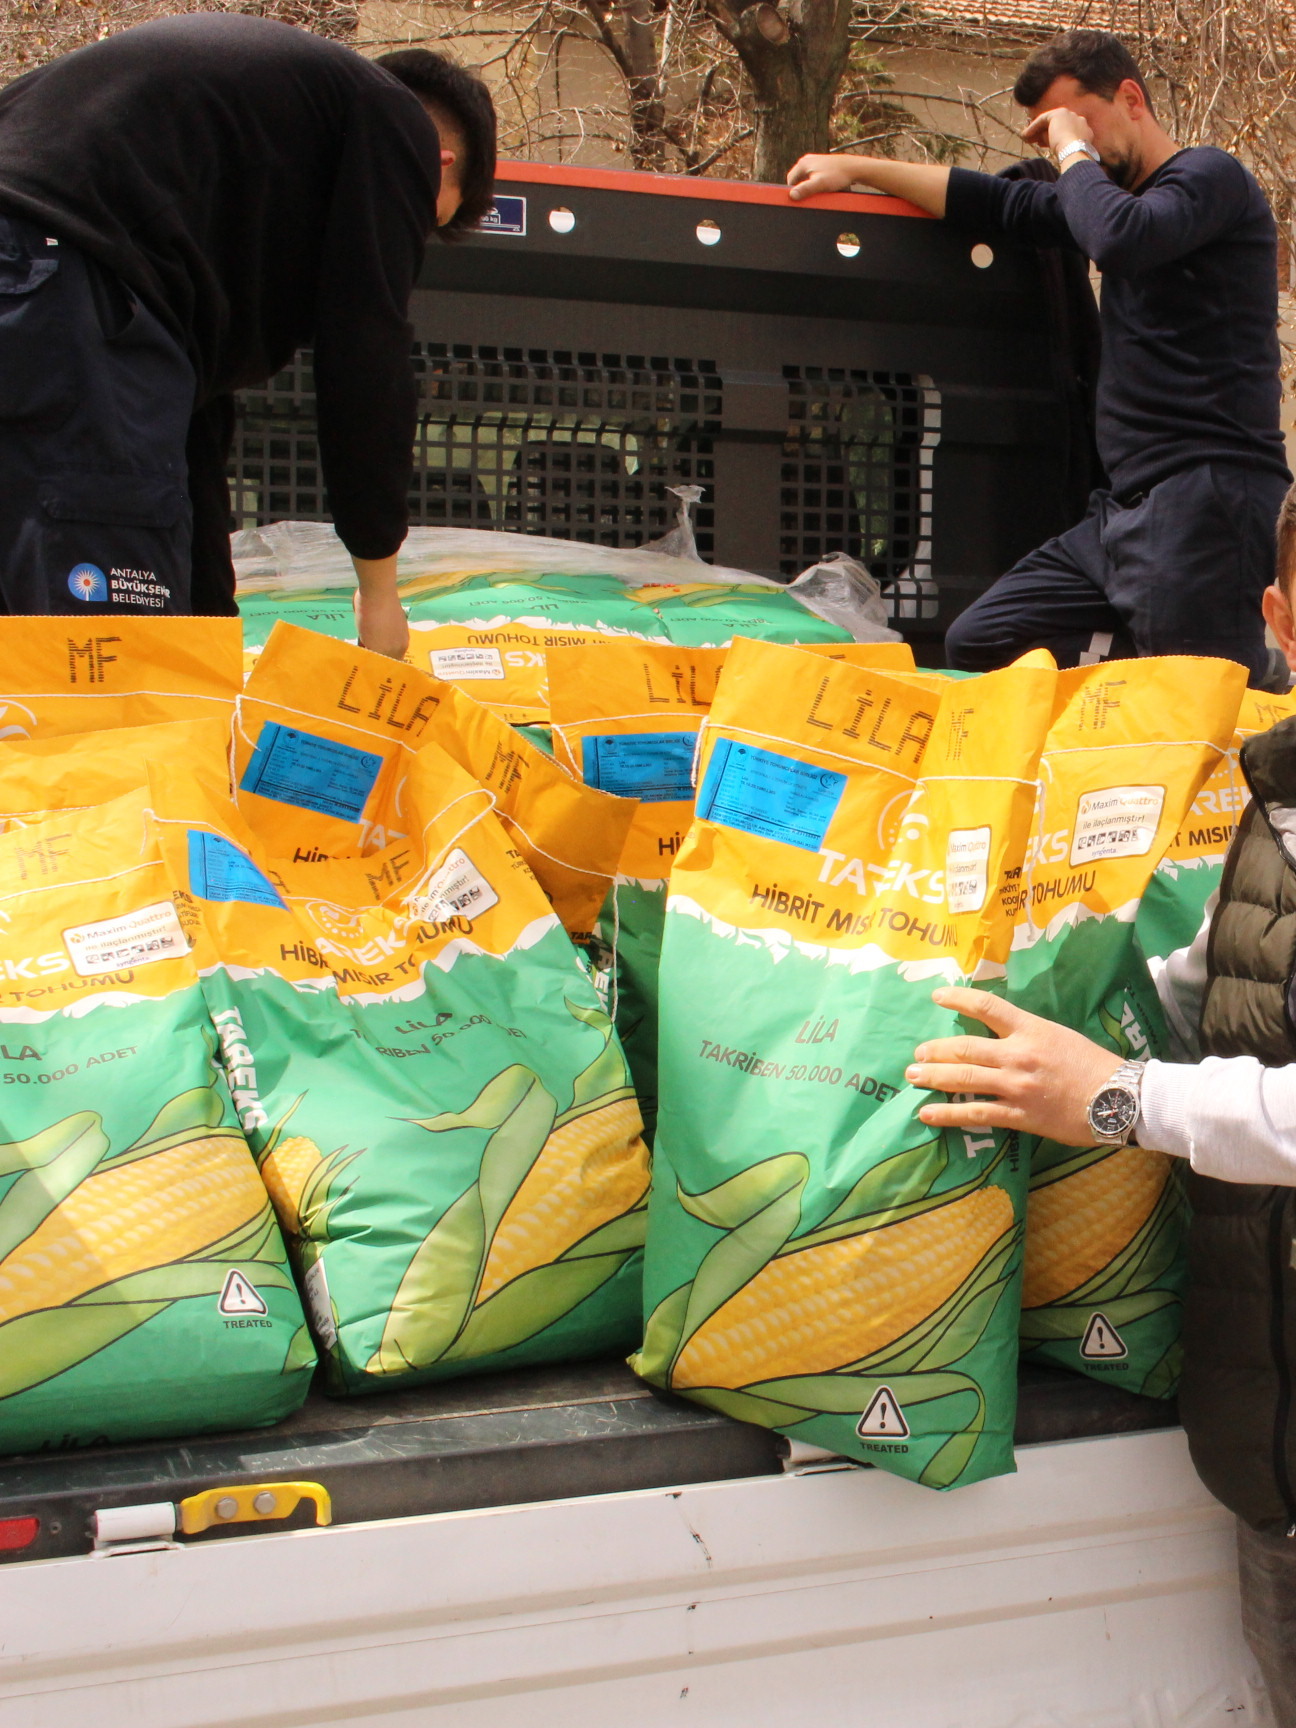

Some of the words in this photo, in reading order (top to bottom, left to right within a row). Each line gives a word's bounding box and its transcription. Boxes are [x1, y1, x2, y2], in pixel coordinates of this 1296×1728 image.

[110, 567, 156, 581] ANTALYA
[112, 593, 164, 608] BELEDİYESİ
[467, 633, 539, 647] TOHUMU
[544, 635, 586, 646] MISIR
[68, 637, 122, 683] MF
[337, 665, 441, 738] LİLA
[1079, 680, 1127, 731] MF
[806, 676, 934, 764] LİLA
[1092, 798, 1118, 811] Maxim
[365, 849, 411, 901] MF
[1031, 870, 1096, 907] TOHUMU
[752, 882, 825, 925] HİBRİT
[827, 908, 873, 936] MIS
[87, 925, 127, 939] Maxim
[129, 910, 172, 929] Quattro
[9, 970, 135, 1001] TOHUMU
[333, 968, 394, 986] MISIR
[395, 1012, 453, 1035] LİLA
[795, 1015, 840, 1045] LİLA
[3, 1063, 79, 1084] 50.000
[86, 1045, 138, 1068] ADET
[699, 1039, 787, 1081] TAKRİBEN
[786, 1064, 843, 1085] 50.000
[844, 1072, 901, 1104] ADET
[223, 1319, 273, 1329] TREATED
[1083, 1363, 1129, 1371] TREATED
[860, 1442, 909, 1454] TREATED
